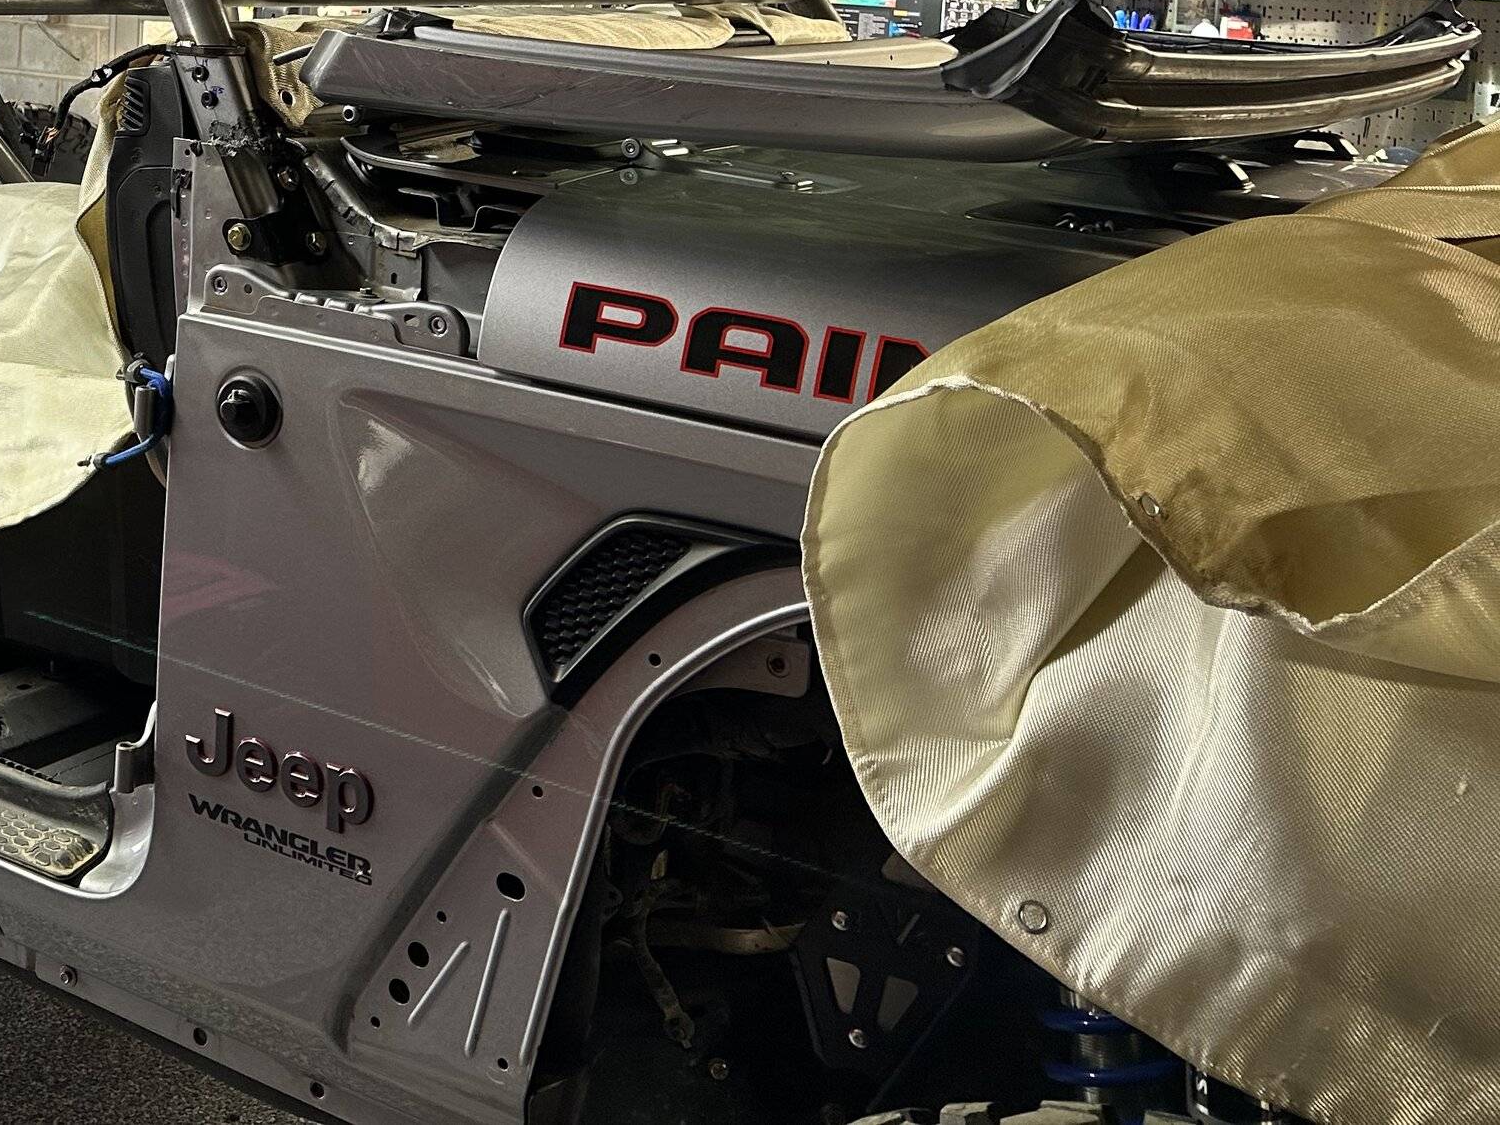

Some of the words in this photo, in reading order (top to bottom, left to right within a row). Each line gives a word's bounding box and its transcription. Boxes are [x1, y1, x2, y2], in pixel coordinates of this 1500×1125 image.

[185, 708, 374, 834] Jeep
[188, 792, 373, 877] WRANGLER
[243, 832, 373, 886] UNLIMITED
